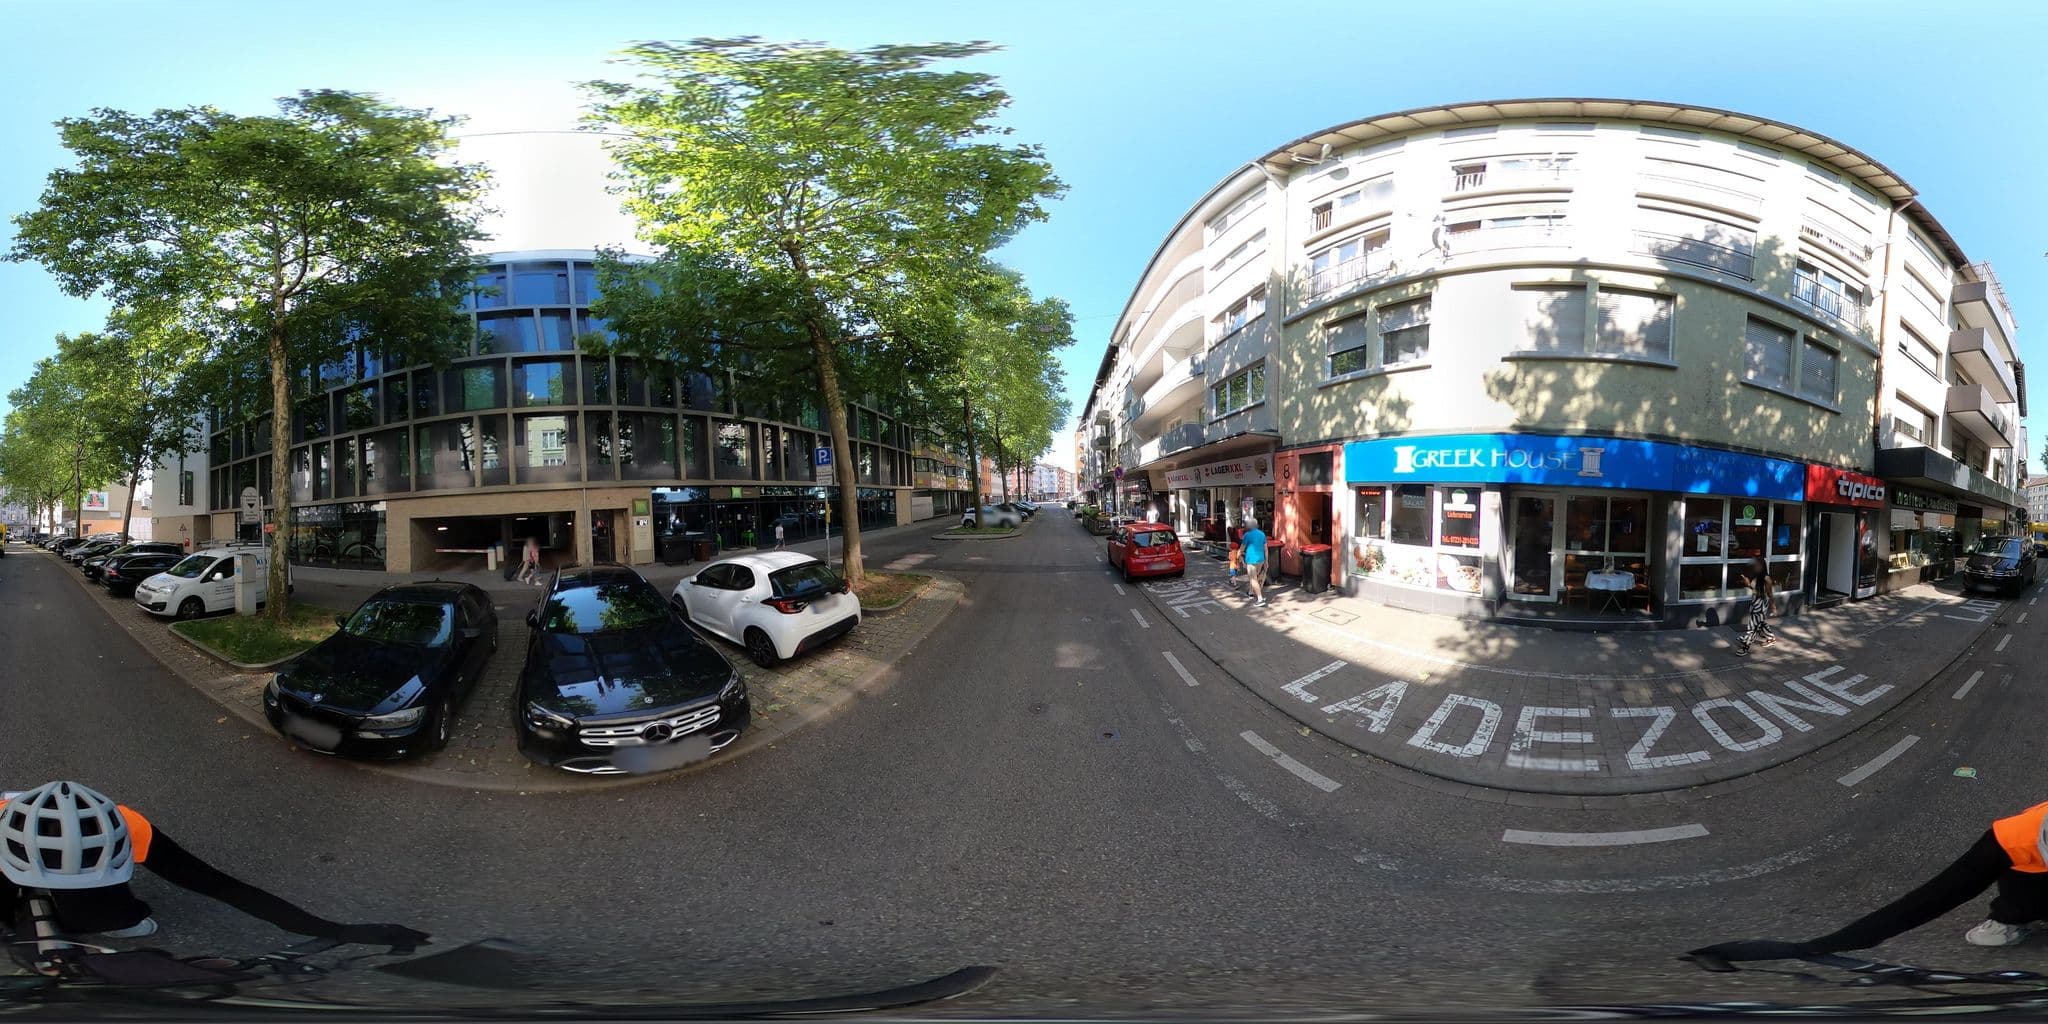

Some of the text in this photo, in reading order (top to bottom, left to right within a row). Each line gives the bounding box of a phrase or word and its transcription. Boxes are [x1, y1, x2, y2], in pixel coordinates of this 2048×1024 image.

[818, 450, 828, 464] P
[1413, 448, 1576, 470] GREEK HOUSE
[1283, 464, 1290, 479] 8
[1838, 475, 1885, 501] tipico
[1280, 660, 1895, 772] LADEZONE
